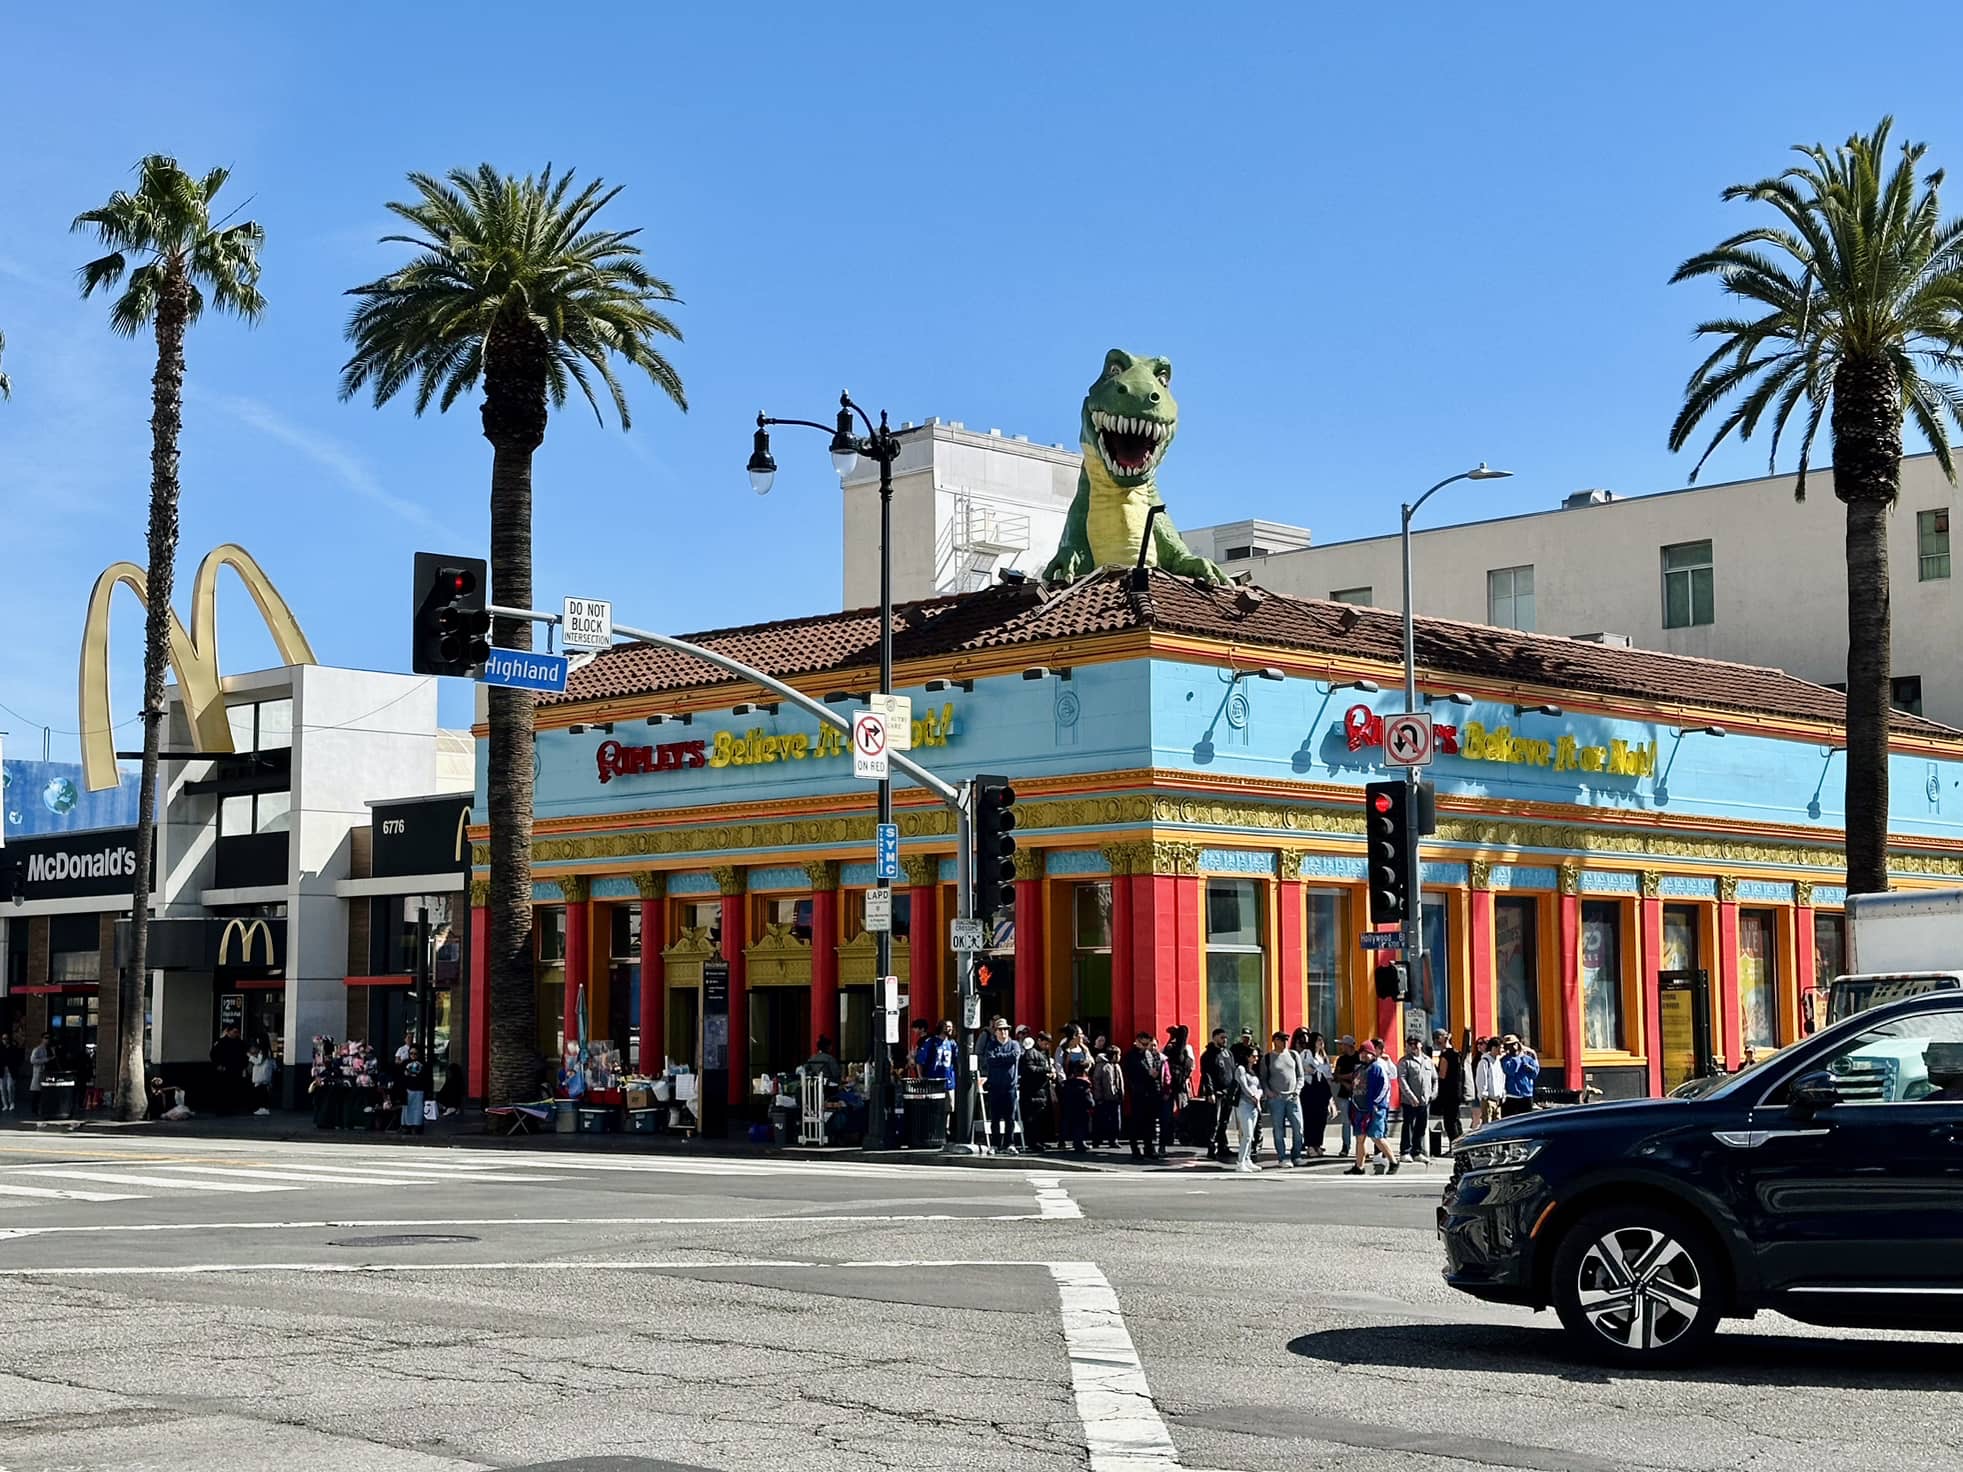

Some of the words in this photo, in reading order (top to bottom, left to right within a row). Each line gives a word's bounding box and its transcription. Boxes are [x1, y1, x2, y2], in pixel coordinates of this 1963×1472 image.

[570, 601, 583, 615] DO
[587, 604, 605, 617] NOT
[571, 617, 602, 632] BLOCK
[564, 633, 609, 645] INTERSECTION
[485, 656, 559, 681] Highland
[709, 728, 805, 768] Believe
[912, 703, 953, 748] ot!
[1461, 722, 1550, 766] Believe
[1607, 739, 1656, 777] Not!
[857, 761, 868, 771] ON
[870, 762, 885, 772] RED
[382, 819, 405, 835] 6776
[886, 828, 896, 875] SYNC
[27, 846, 137, 882] McDonald's
[867, 890, 889, 900] LAPD
[953, 936, 965, 948] OK
